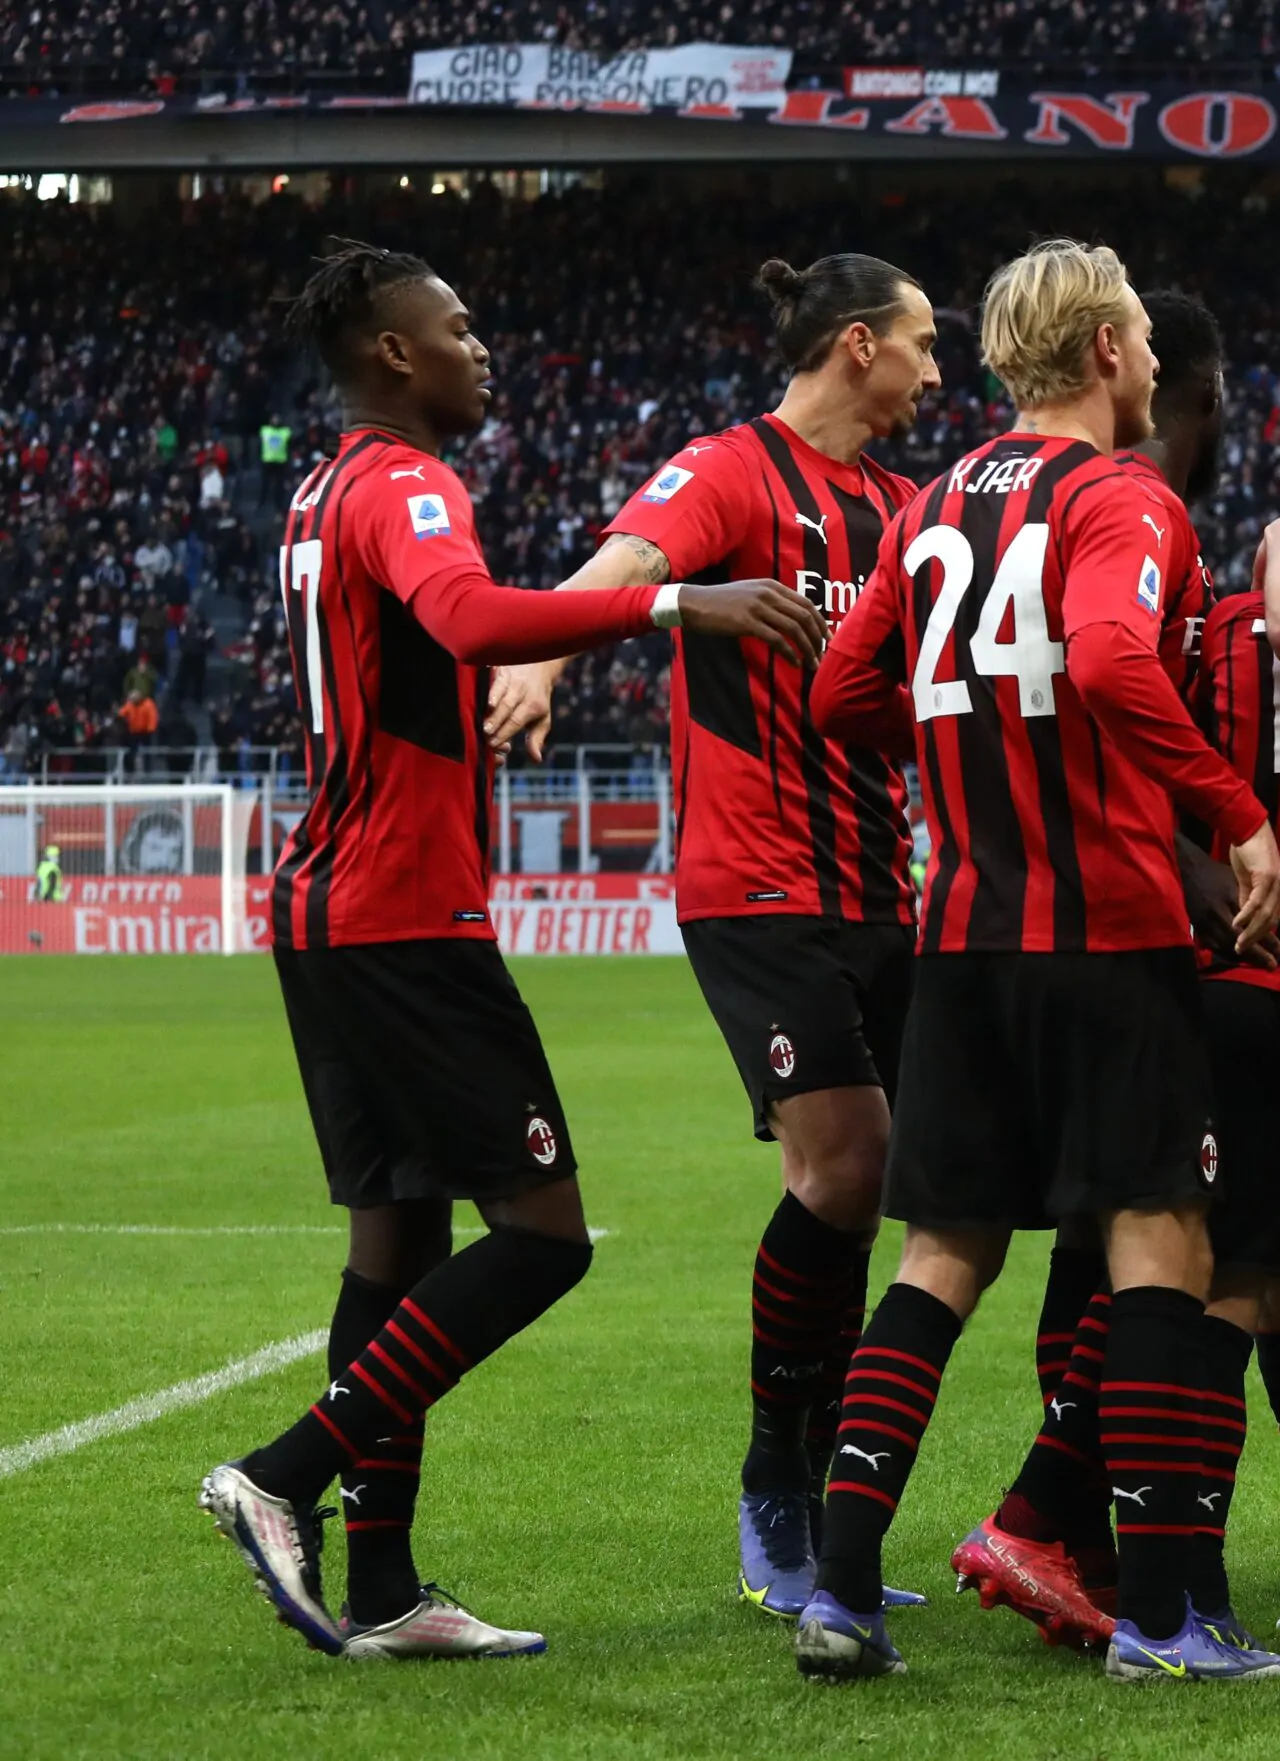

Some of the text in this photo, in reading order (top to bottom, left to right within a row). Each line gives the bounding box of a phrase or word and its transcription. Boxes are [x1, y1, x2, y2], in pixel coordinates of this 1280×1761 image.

[448, 49, 523, 79] CIAO
[947, 457, 1044, 494] KJÆR
[903, 523, 1066, 723] 24
[74, 905, 270, 953] Emirae
[533, 907, 654, 954] BETTER
[986, 1535, 1040, 1597] ULTRA
